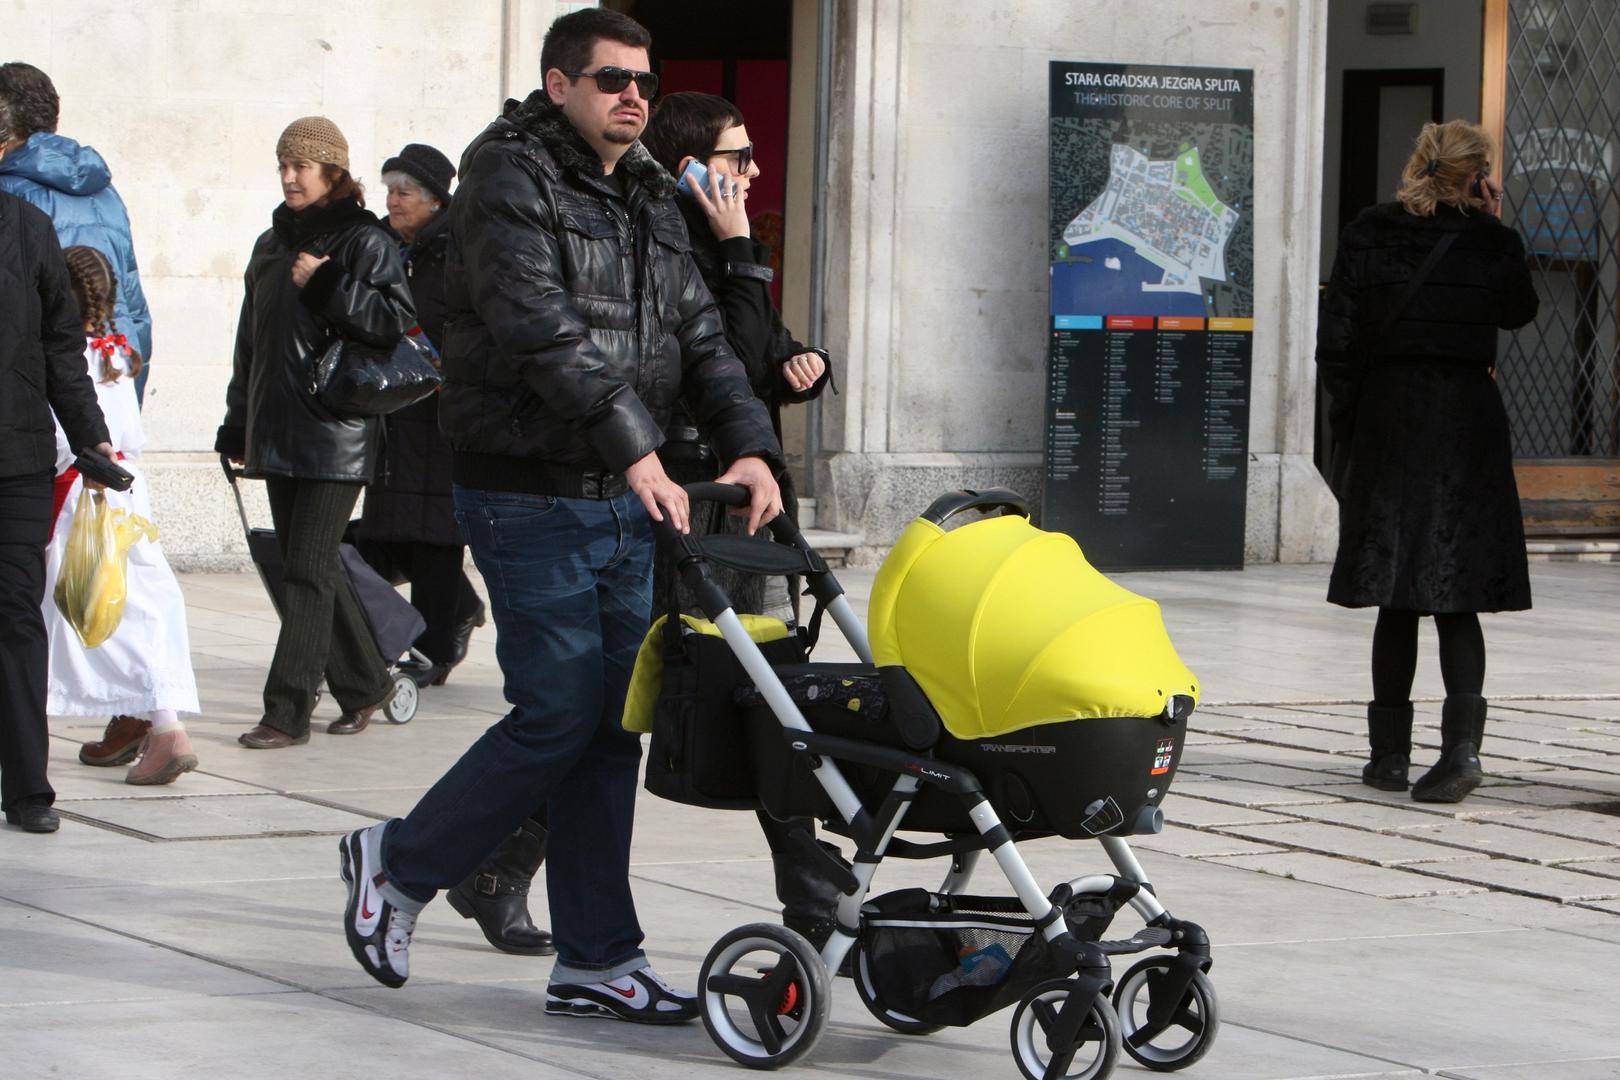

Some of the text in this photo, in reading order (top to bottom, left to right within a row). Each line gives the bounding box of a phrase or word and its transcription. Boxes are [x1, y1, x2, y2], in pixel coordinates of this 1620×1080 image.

[1065, 72, 1241, 92] STARA GRADSKA JEZGRA SPLITA
[1074, 92, 1233, 111] THE HISTORIC CORE OF SPLIT
[980, 743, 1057, 754] TRANSPORTER
